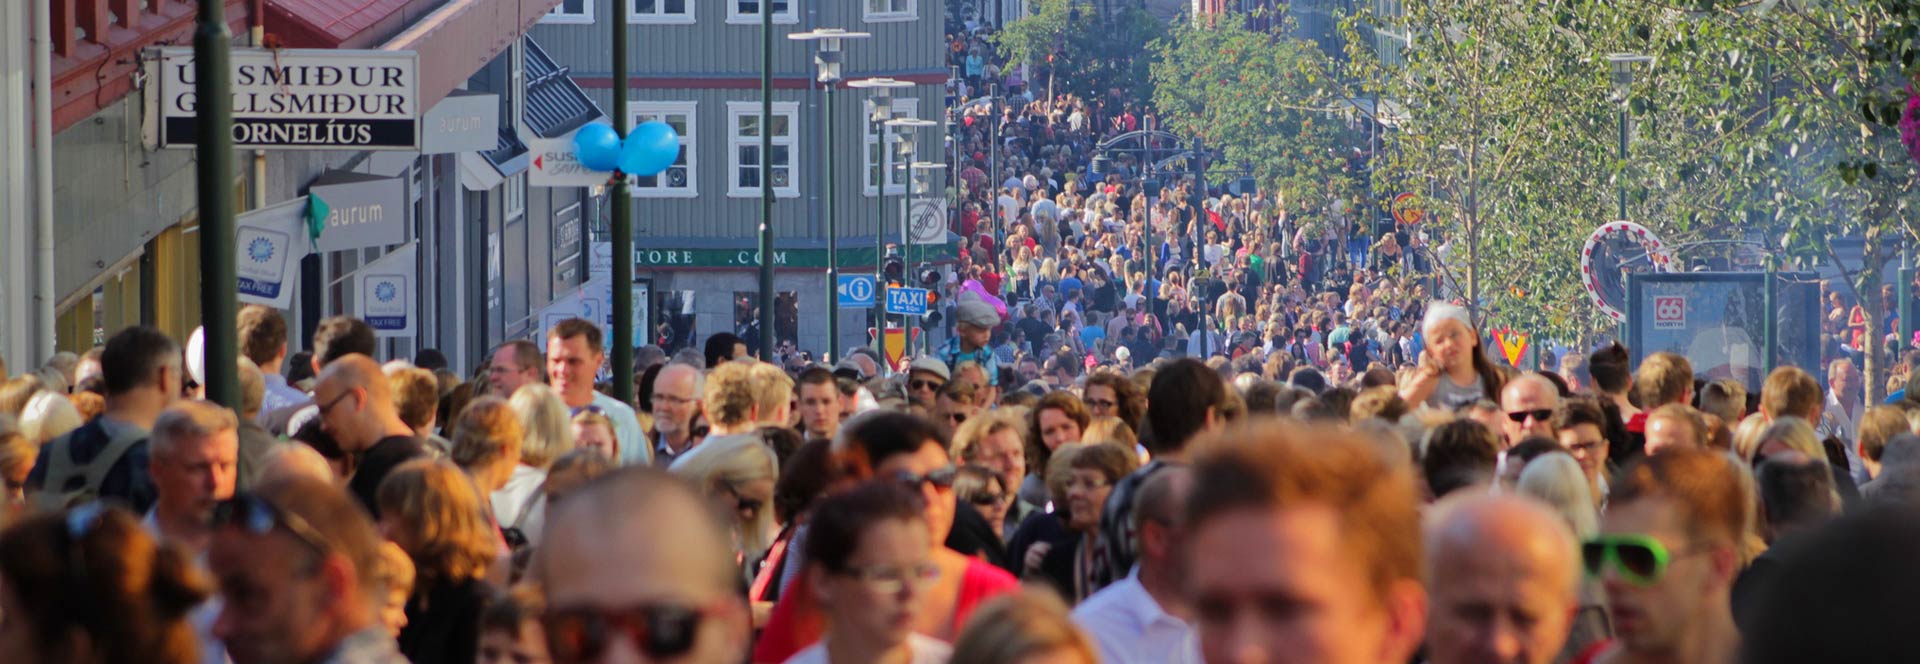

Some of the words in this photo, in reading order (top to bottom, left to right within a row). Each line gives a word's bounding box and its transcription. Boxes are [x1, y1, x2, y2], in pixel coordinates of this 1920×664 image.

[176, 58, 405, 88] ÚSMIÐUR
[175, 91, 406, 115] GLLSMIÐUR
[231, 118, 372, 144] ORNELÍUS
[440, 116, 481, 133] aurum
[331, 204, 383, 226] aurum
[635, 250, 693, 264] TORE
[890, 290, 924, 307] TAXI
